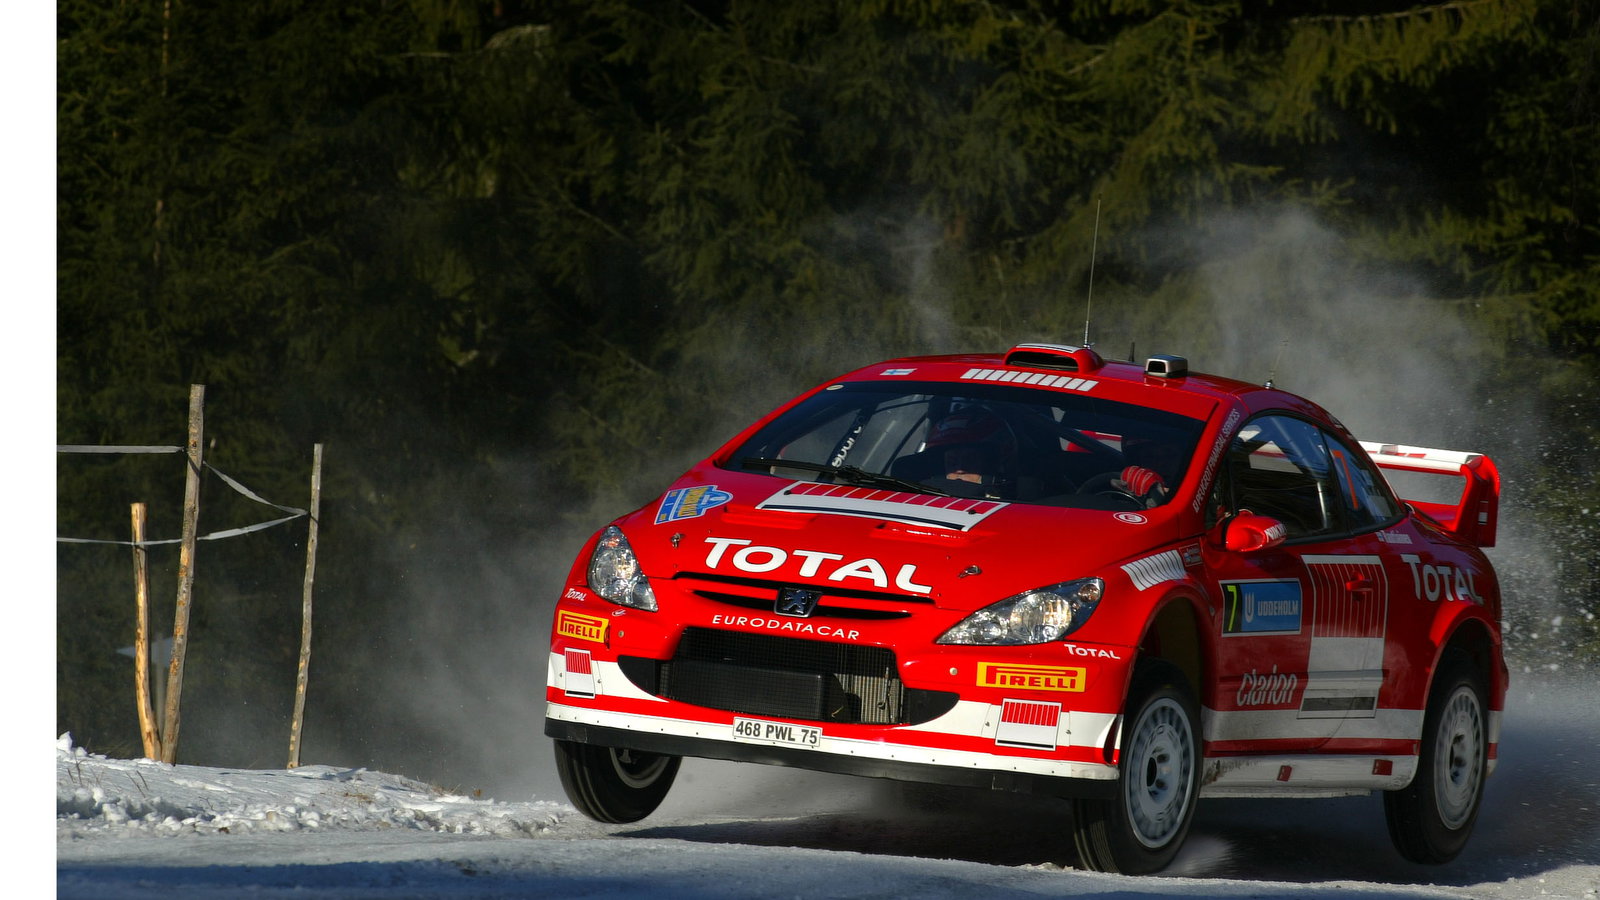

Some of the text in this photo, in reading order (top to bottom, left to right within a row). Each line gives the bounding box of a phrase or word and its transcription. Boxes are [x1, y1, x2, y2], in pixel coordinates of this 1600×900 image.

[704, 537, 933, 594] TOTAL
[1402, 554, 1484, 604] TOTAL
[565, 588, 587, 601] TOTAL
[1227, 585, 1238, 632] 7
[1257, 600, 1300, 617] UDDEHOLM
[560, 613, 602, 639] PIRELLI
[712, 614, 860, 641] EURODATACAR
[1064, 644, 1121, 660] TOTAL
[986, 665, 1078, 689] PIRELLI
[736, 721, 818, 744] 468 PWL 75
